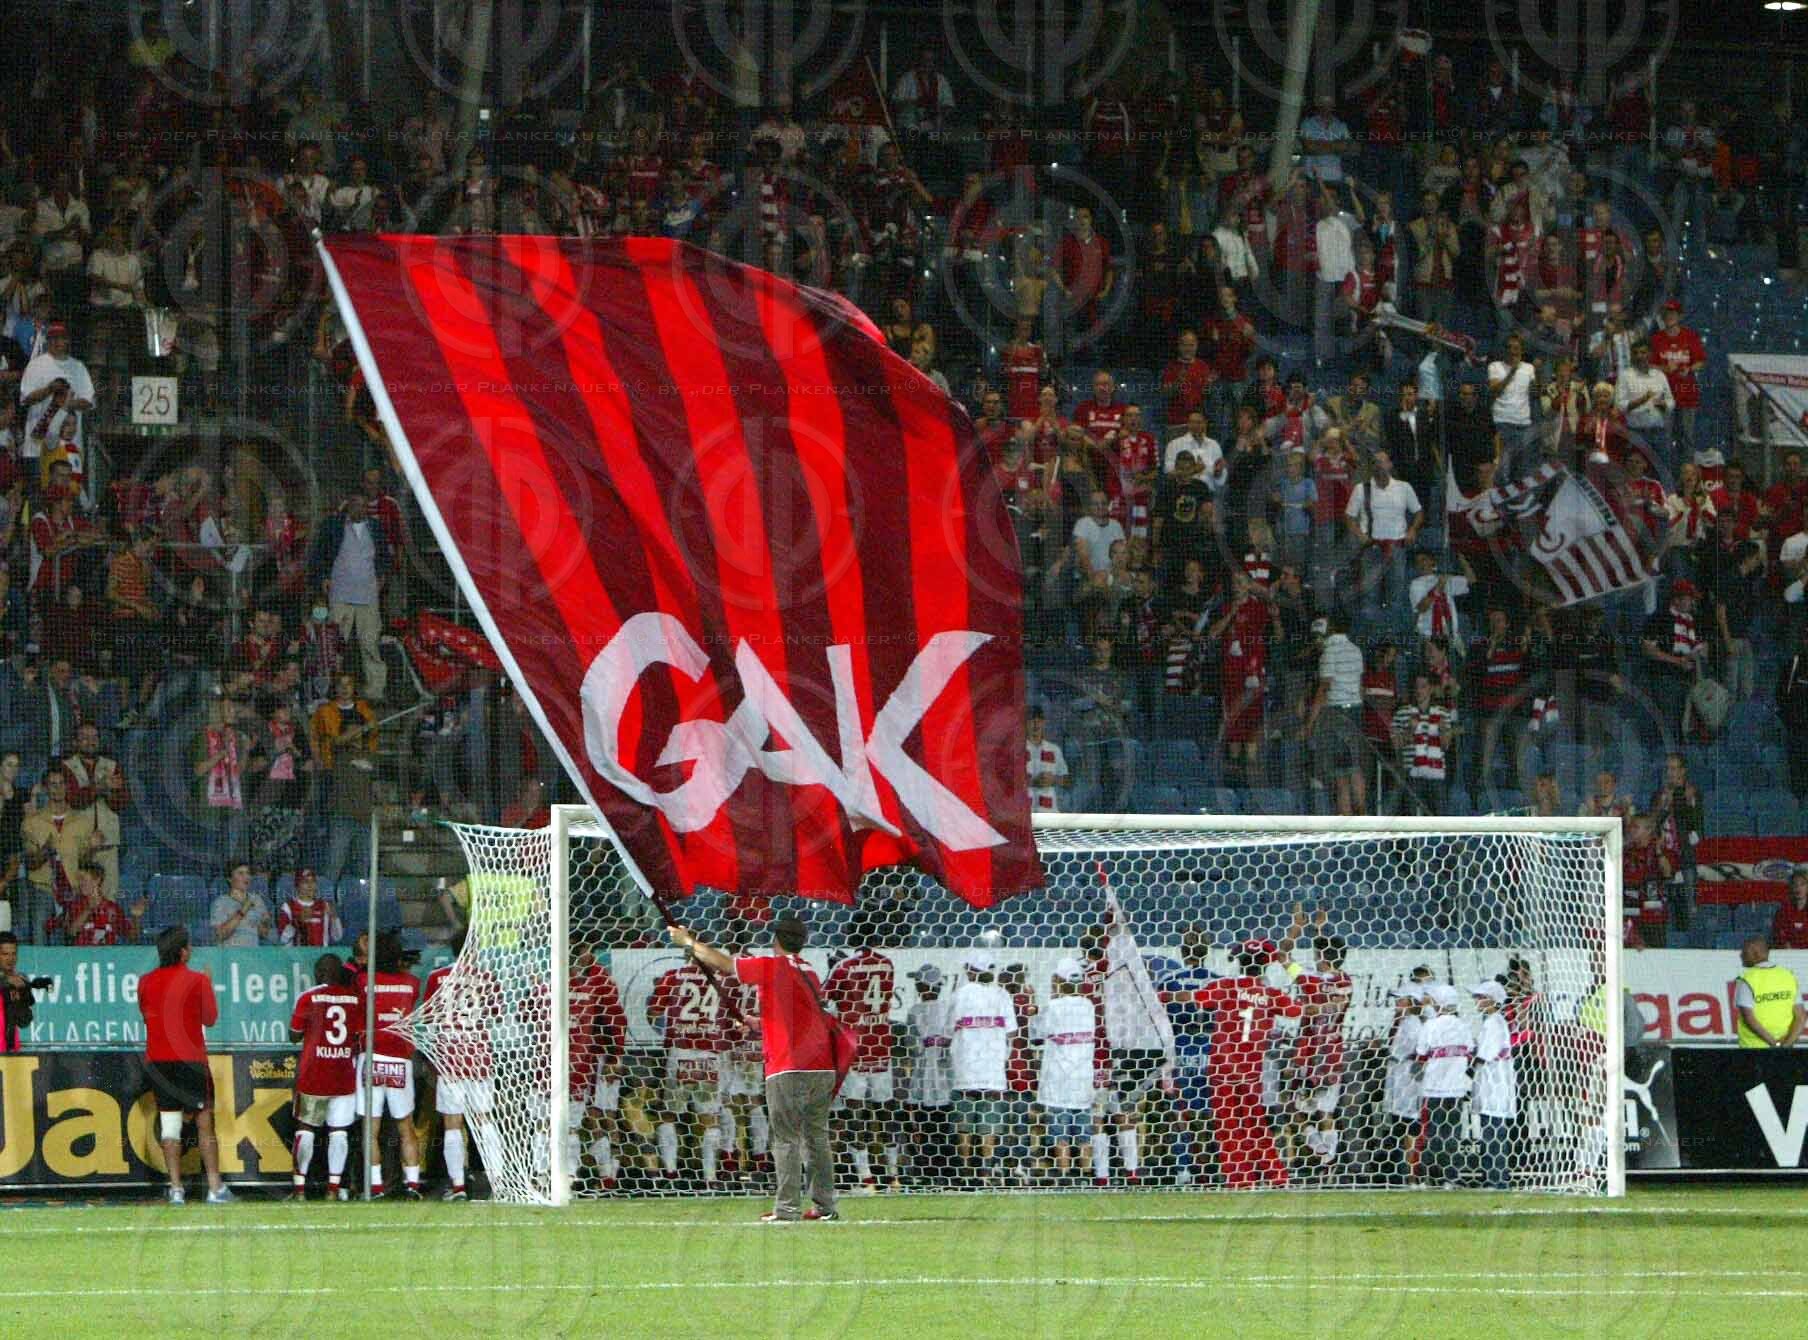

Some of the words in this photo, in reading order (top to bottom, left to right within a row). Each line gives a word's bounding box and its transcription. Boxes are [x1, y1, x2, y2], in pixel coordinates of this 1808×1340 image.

[139, 385, 170, 415] 25
[580, 611, 1008, 852] GAK
[680, 982, 720, 1022] 24
[864, 974, 886, 1013] 4
[325, 1005, 348, 1046] 3
[1239, 1007, 1254, 1042] 1
[372, 1062, 405, 1076] LEINE
